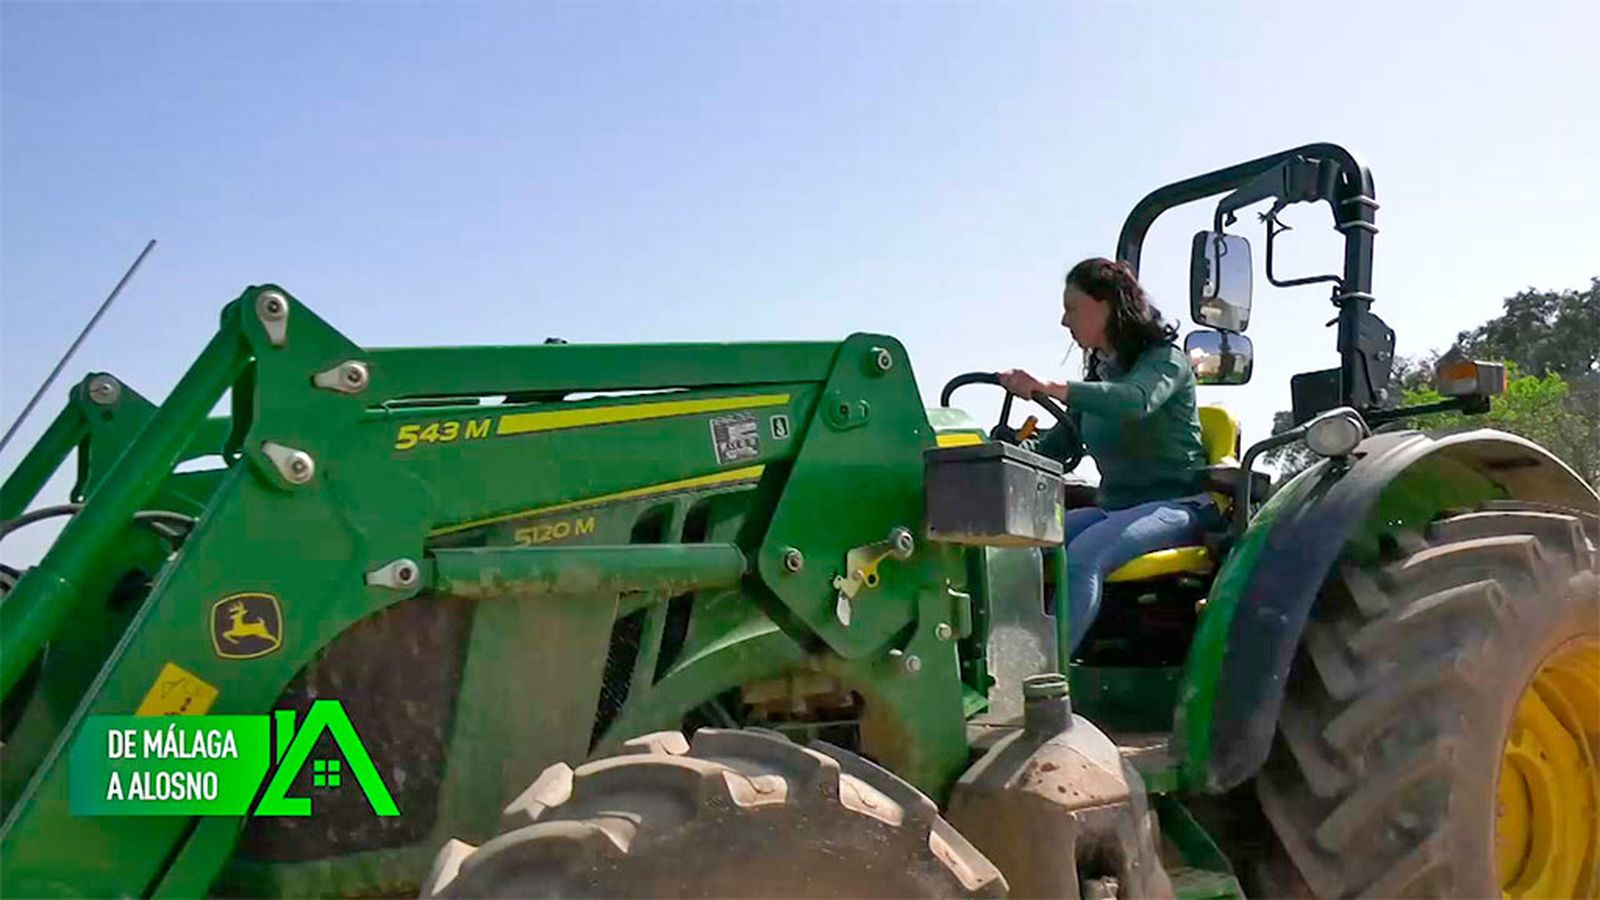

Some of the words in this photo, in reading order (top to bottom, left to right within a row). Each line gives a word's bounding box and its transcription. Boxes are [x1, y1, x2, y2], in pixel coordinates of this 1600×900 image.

[394, 420, 460, 450] 543
[464, 418, 492, 440] M
[514, 521, 569, 547] 5120
[574, 516, 595, 536] M
